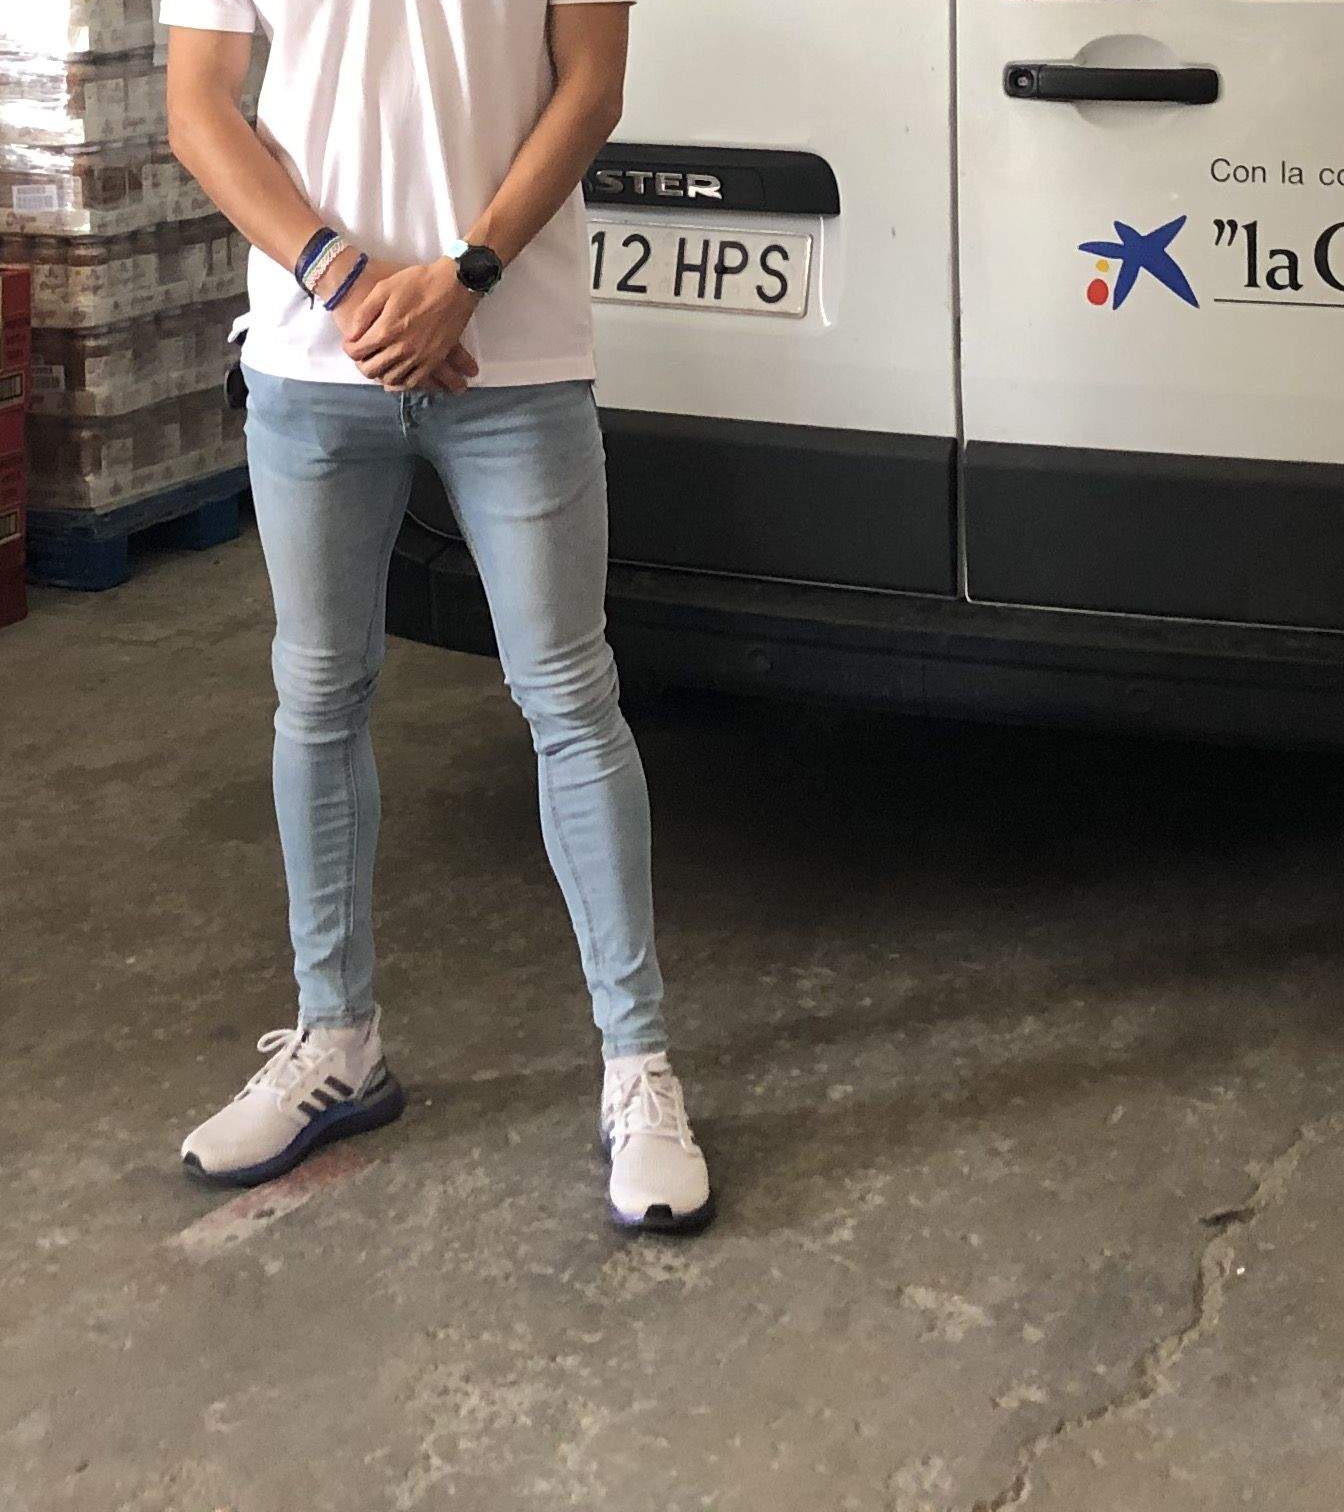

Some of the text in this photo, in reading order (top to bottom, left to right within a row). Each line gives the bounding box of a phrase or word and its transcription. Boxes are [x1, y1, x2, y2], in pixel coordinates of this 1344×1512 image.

[581, 170, 723, 200] STER
[1210, 158, 1267, 184] Con
[1281, 160, 1304, 185] la
[673, 237, 790, 304] HPS
